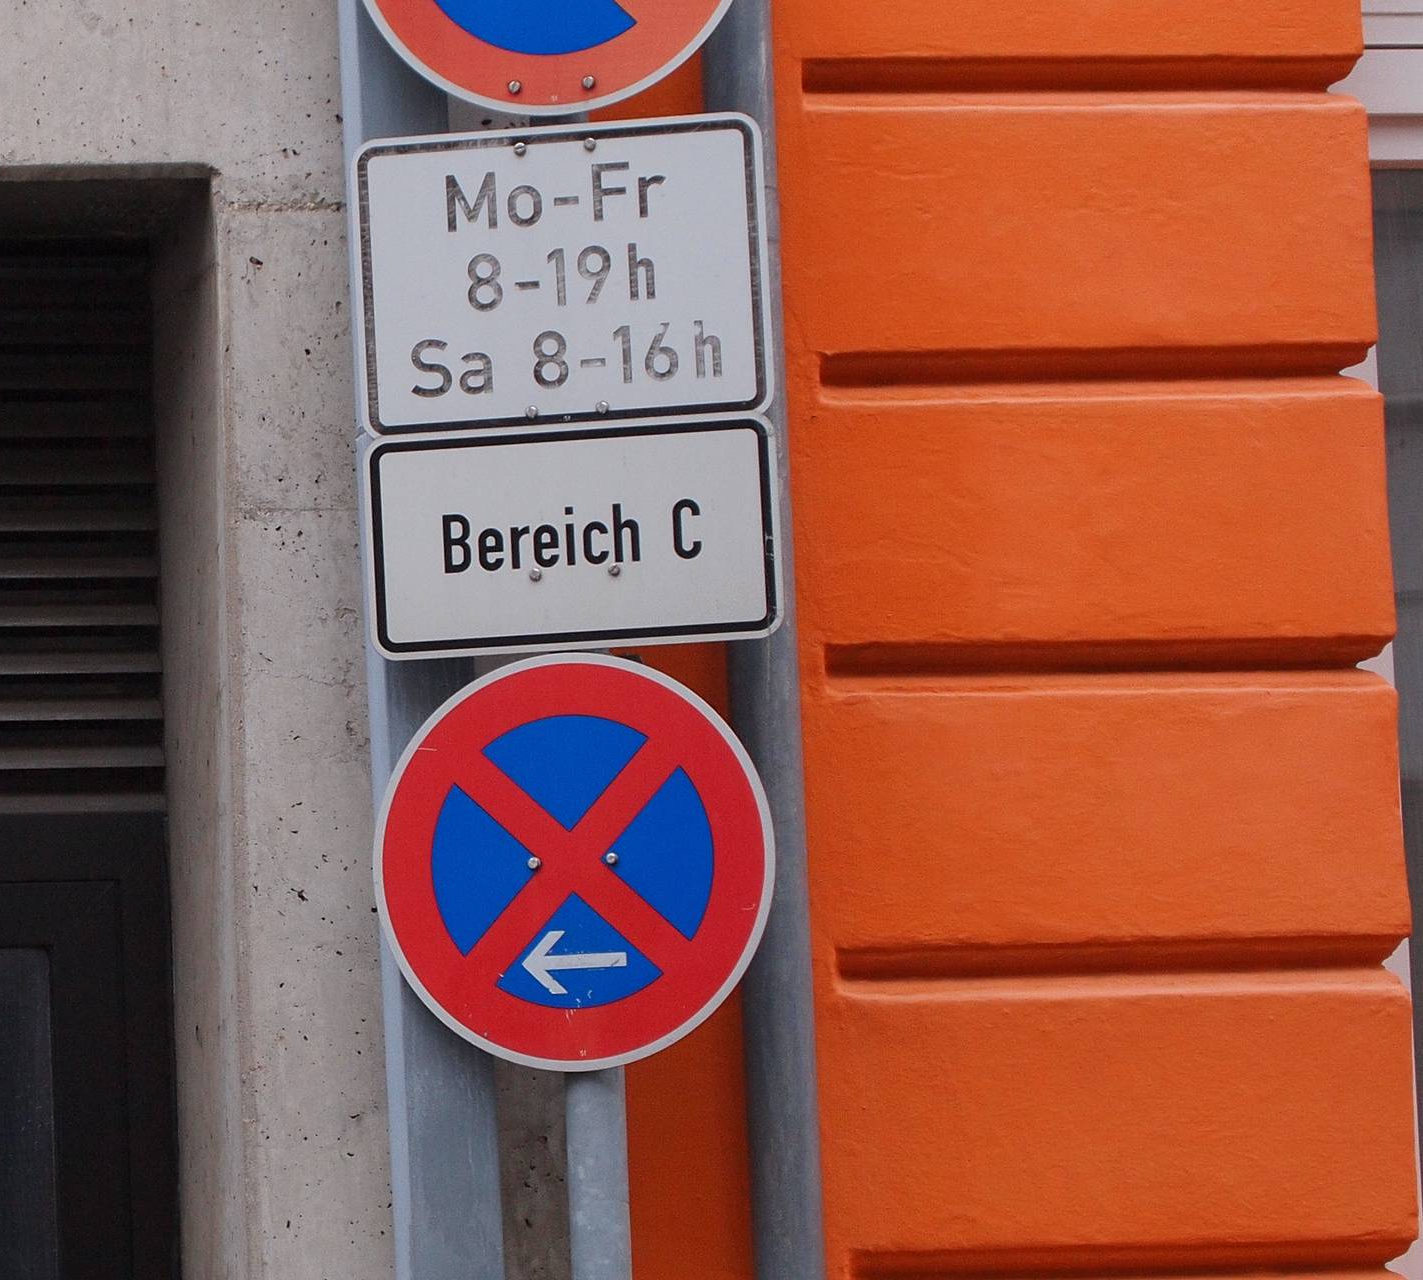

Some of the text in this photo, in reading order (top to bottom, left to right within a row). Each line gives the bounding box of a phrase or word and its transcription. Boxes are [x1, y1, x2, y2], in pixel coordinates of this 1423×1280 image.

[445, 161, 666, 233] Mo-Fr
[410, 338, 494, 398] Sa
[441, 498, 702, 574] Bereich C
